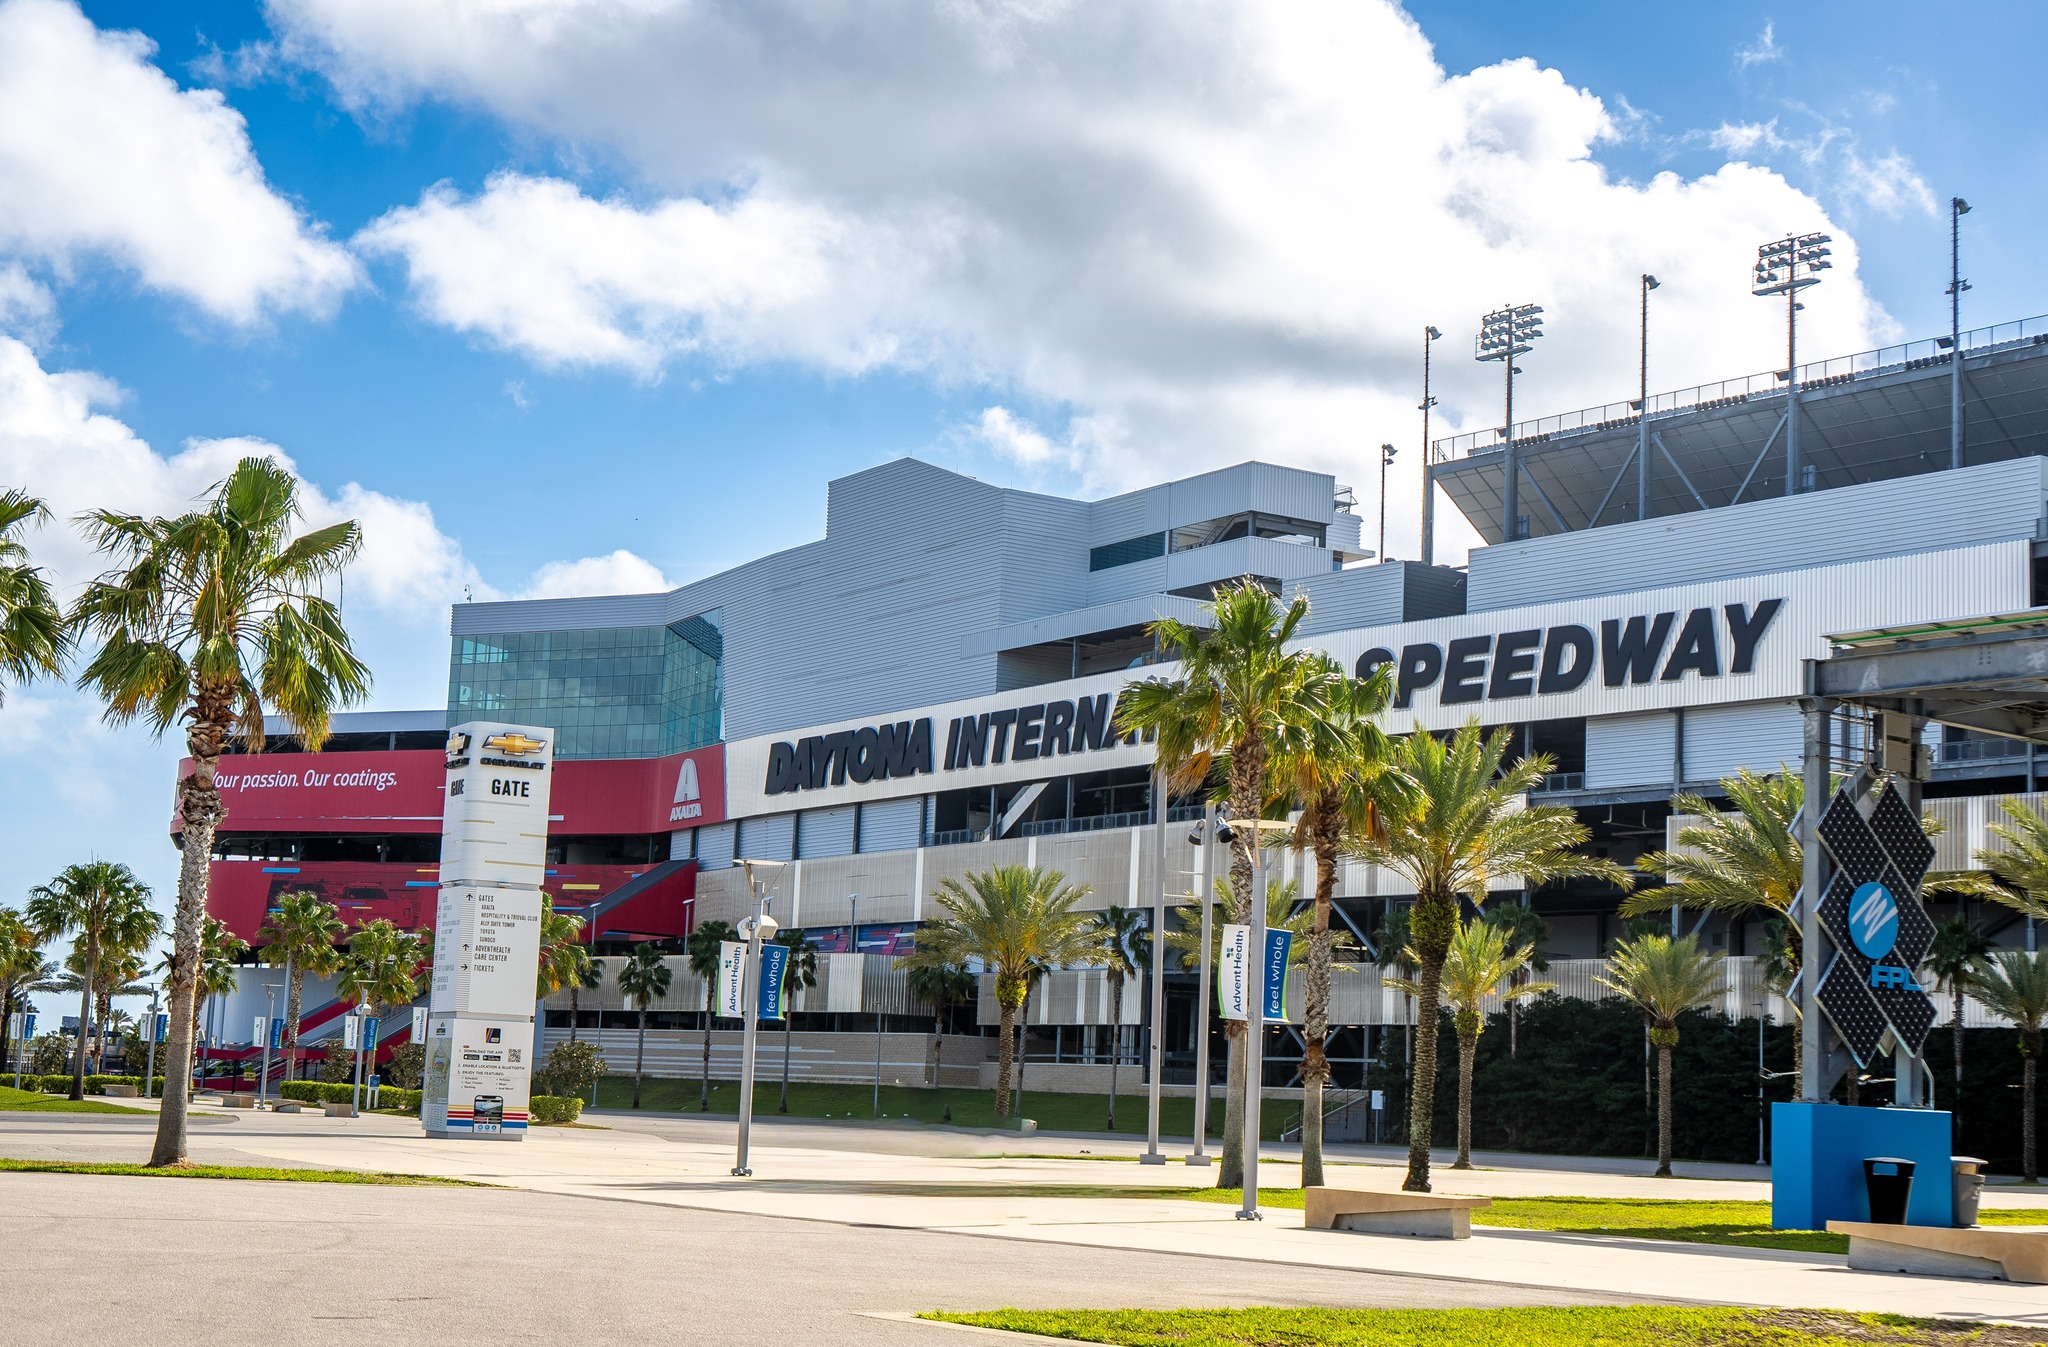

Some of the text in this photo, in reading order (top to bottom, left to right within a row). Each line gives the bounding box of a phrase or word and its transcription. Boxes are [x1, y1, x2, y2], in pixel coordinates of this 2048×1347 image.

[1355, 597, 1789, 711] SPEEDWAY
[480, 757, 546, 770] CHEVROLET
[764, 717, 936, 795] DAYTONA
[240, 770, 299, 792] passion.
[303, 769, 331, 787] Our
[333, 769, 397, 791] coatings.
[491, 779, 530, 797] GATE
[669, 803, 703, 822] AXALTA
[479, 894, 494, 902] GATES
[481, 912, 506, 920] HOSPITALITY
[474, 953, 507, 962] CARE CENTER
[475, 945, 511, 954] ADVENTHEALTH
[474, 964, 495, 973] TICKETS
[1233, 930, 1244, 1012] AdventHealth
[1871, 964, 1921, 991] FPL
[729, 946, 741, 1012] AdventHealth
[767, 990, 777, 1012] feel
[1270, 985, 1280, 1014] feel
